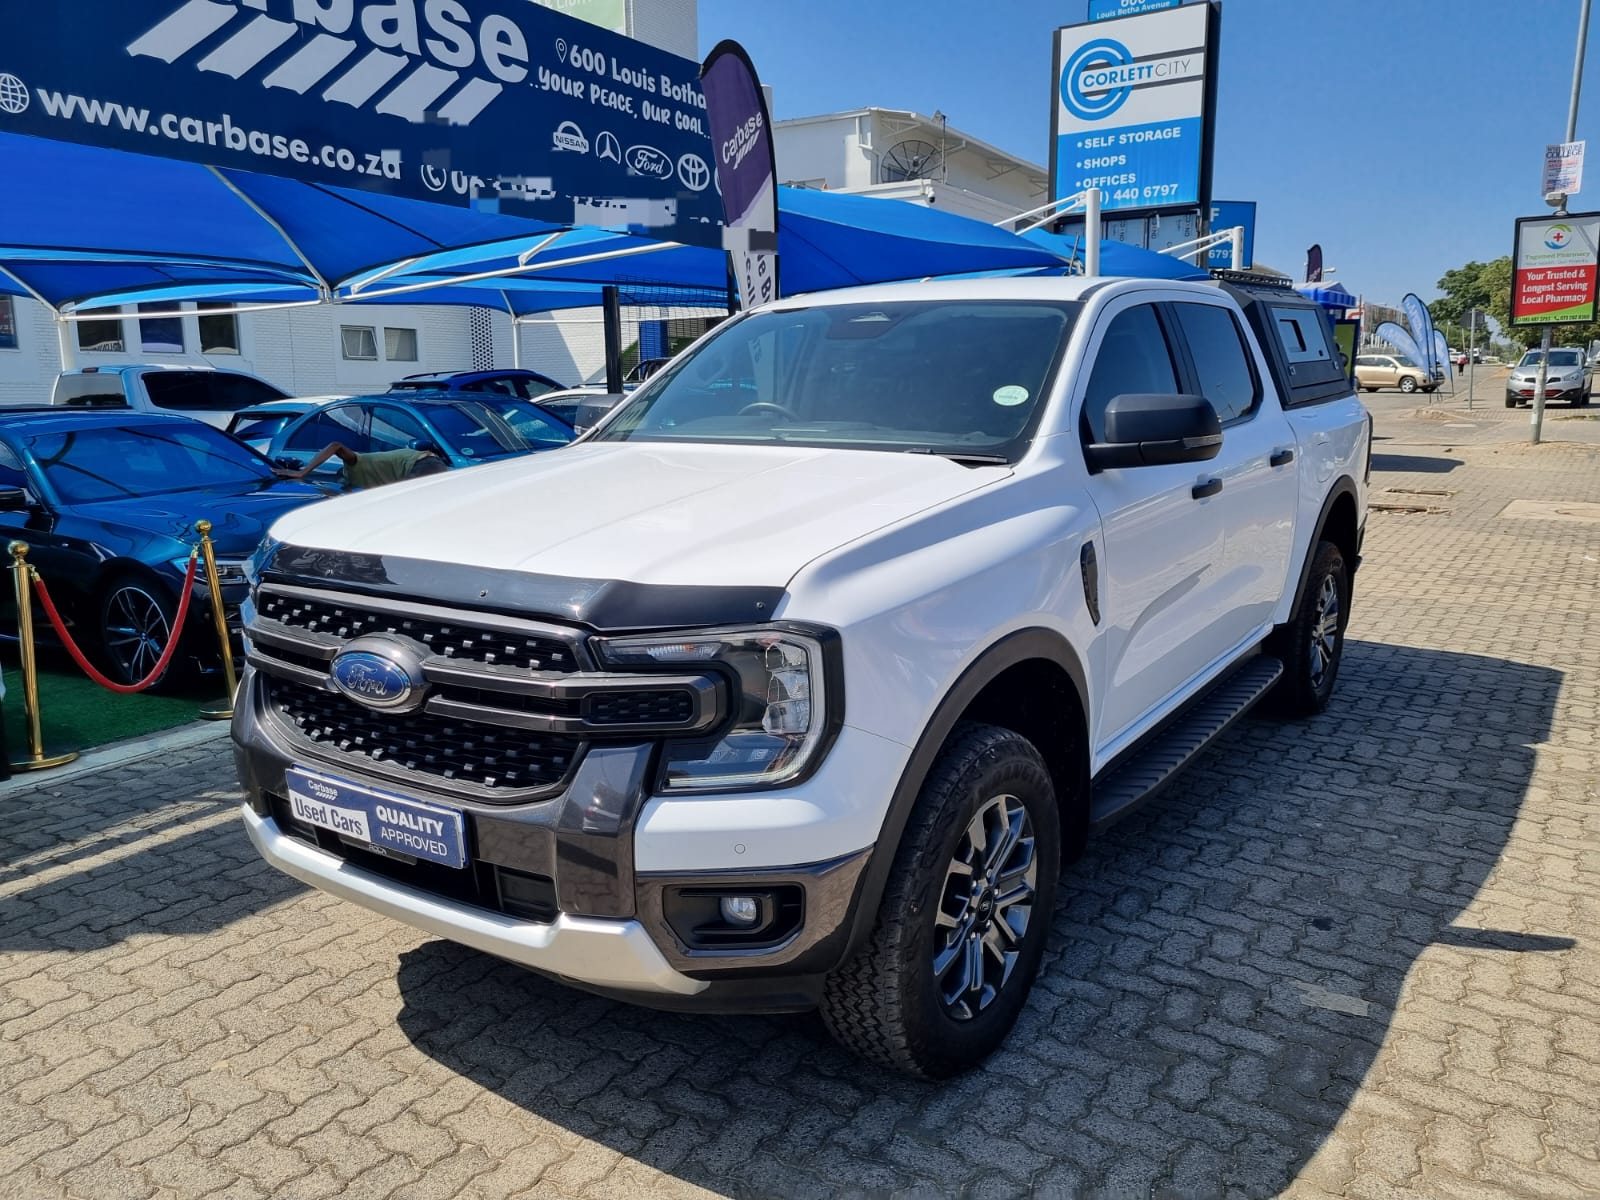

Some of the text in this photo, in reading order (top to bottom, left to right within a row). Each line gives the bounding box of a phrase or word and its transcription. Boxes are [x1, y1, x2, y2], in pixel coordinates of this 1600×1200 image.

[1096, 1, 1171, 19] Louis Botha Avenue
[570, 45, 708, 110] 600 Louis Botha
[642, 100, 671, 125] OUR
[36, 87, 402, 181] www.carbase.co.za
[555, 134, 588, 150] NISSAN
[722, 111, 763, 164] Carbase
[1084, 127, 1181, 149] SELF STORAGE
[634, 149, 665, 174] Ford
[1084, 155, 1126, 169] SHOPS
[1082, 173, 1136, 188] OFFICES
[1113, 188, 1139, 200] 440
[1143, 183, 1178, 198] 6797
[1527, 269, 1586, 281] Your Trusted &
[1522, 281, 1588, 293] Longest Serving
[1522, 294, 1587, 304] Local Pharmacy
[346, 663, 388, 695] Ford
[307, 779, 338, 797] Carbase
[294, 797, 363, 836] Used Cars
[375, 805, 444, 836] QUALITY
[381, 826, 448, 857] APPROVED
